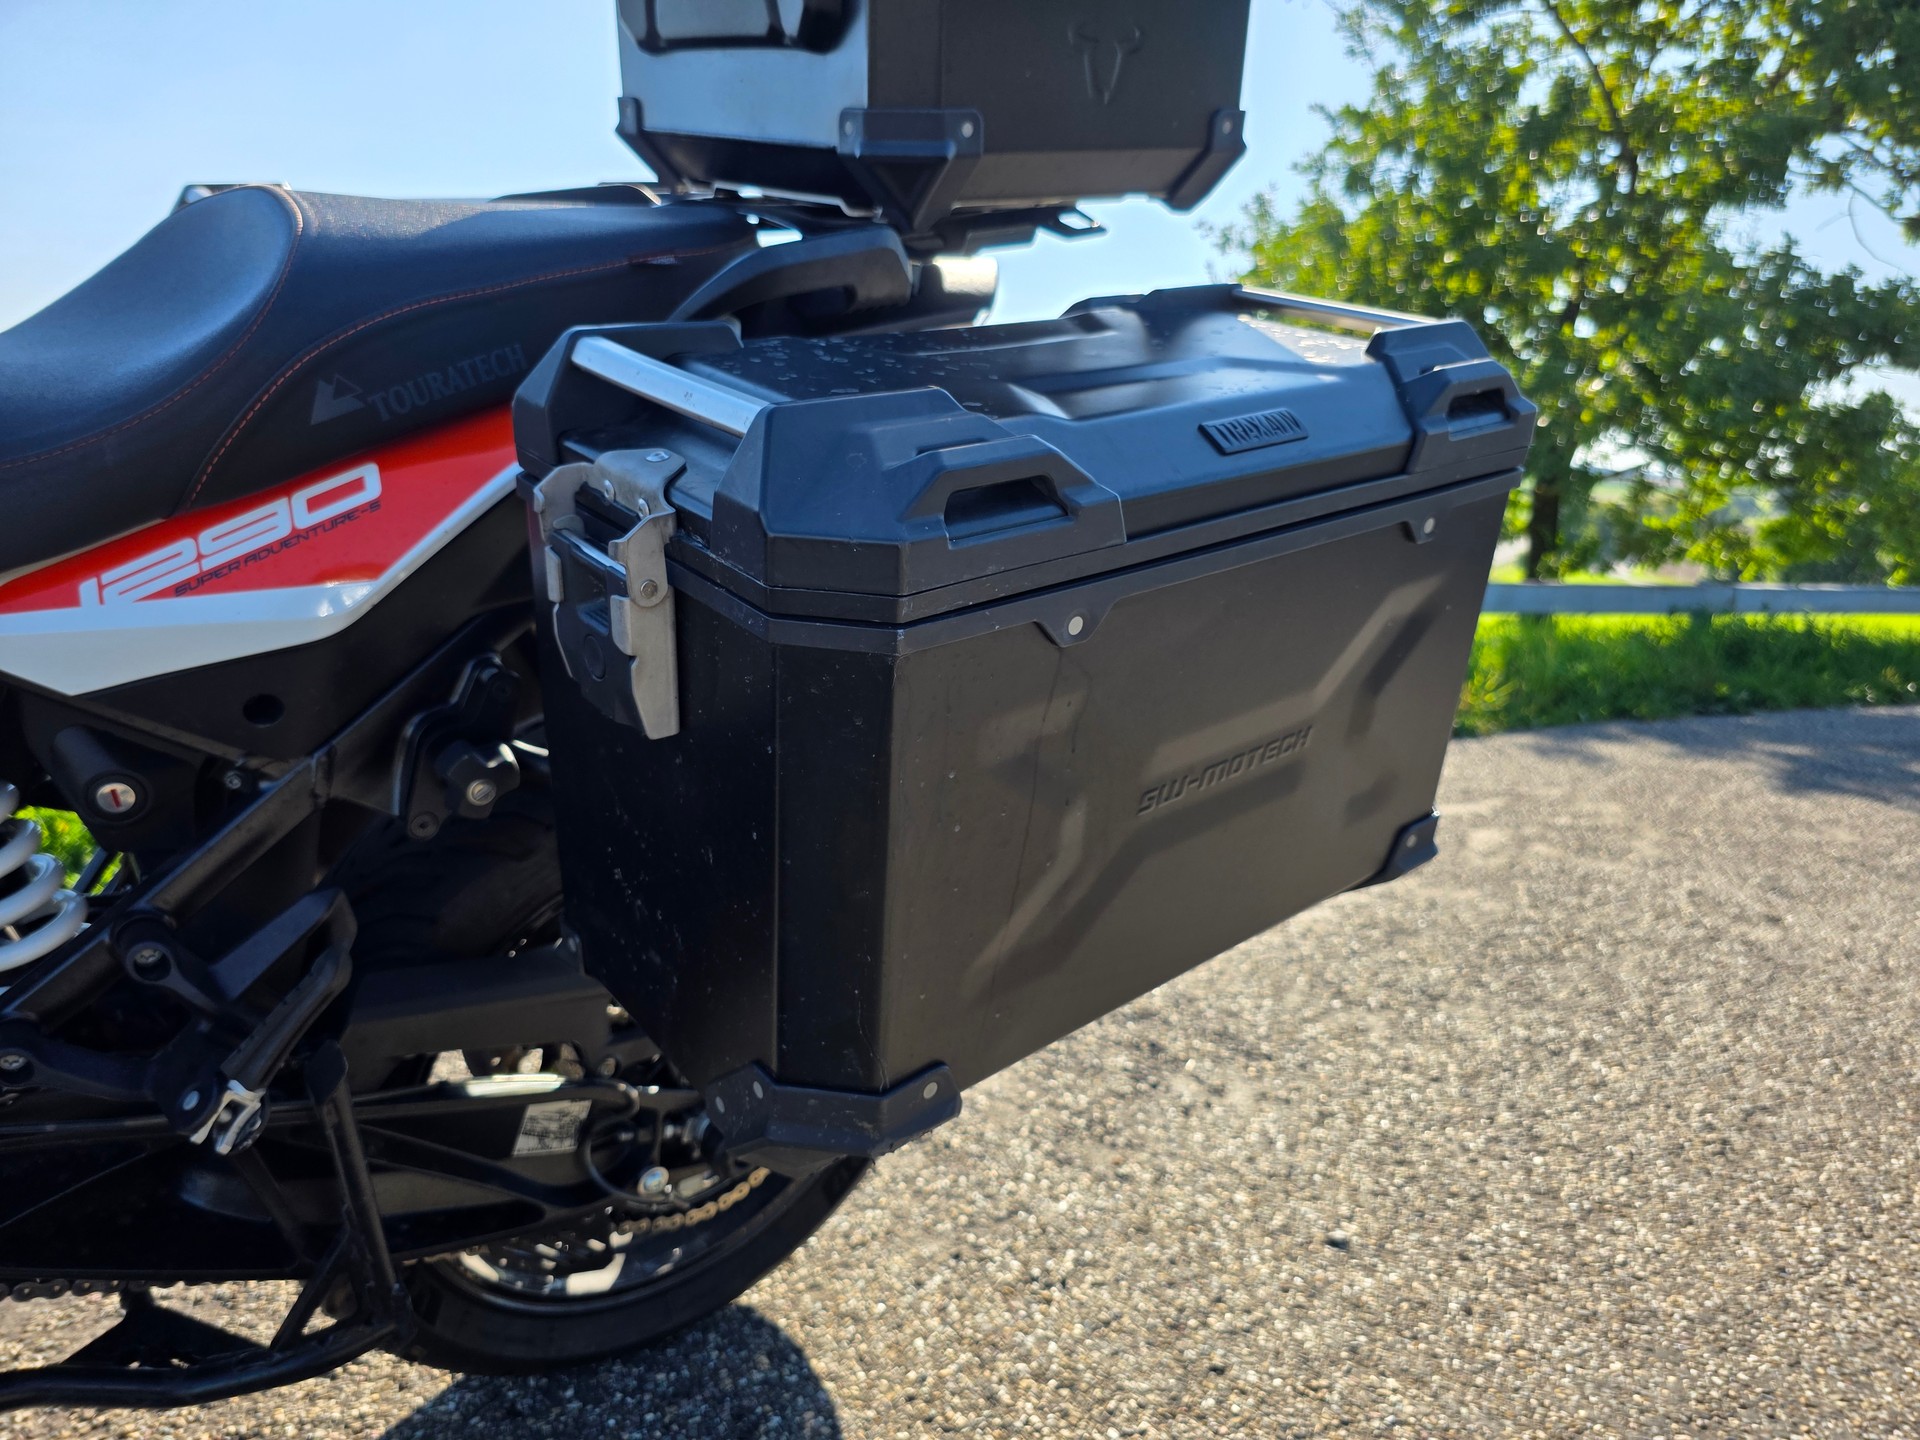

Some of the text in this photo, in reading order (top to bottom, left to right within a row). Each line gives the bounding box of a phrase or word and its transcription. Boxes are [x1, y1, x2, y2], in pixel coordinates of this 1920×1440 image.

[367, 344, 528, 421] TOURATECH
[79, 462, 382, 606] 1290
[173, 561, 241, 599] SUPER
[1136, 725, 1313, 816] SW-MOTECH
